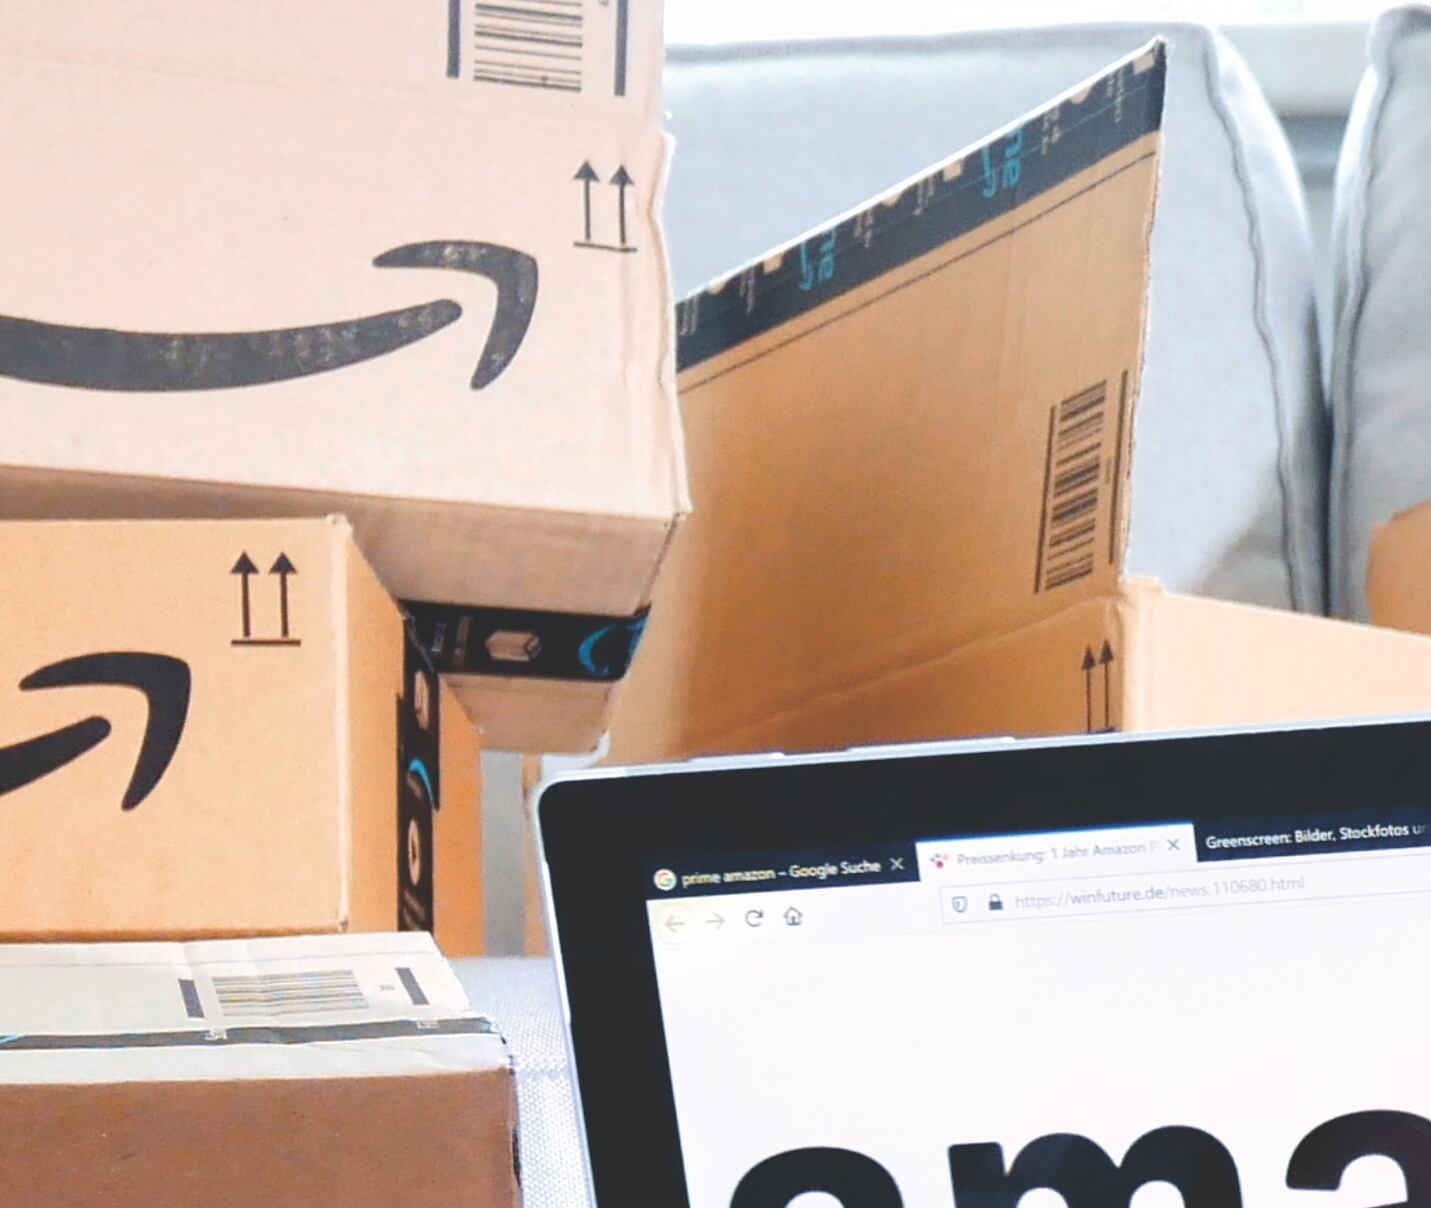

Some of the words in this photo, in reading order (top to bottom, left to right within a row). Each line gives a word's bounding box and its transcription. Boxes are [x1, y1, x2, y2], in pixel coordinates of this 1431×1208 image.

[1206, 832, 1292, 850] Greenscreen:
[1340, 824, 1409, 841] Stockfotos
[957, 848, 1045, 867] Preissenkung:
[1051, 847, 1058, 859] 1
[1062, 845, 1089, 859] Jahr
[1093, 842, 1147, 856] Amazon
[682, 872, 721, 888] prime
[723, 869, 776, 883] amazon
[789, 862, 838, 880] Google
[840, 860, 882, 875] Suche
